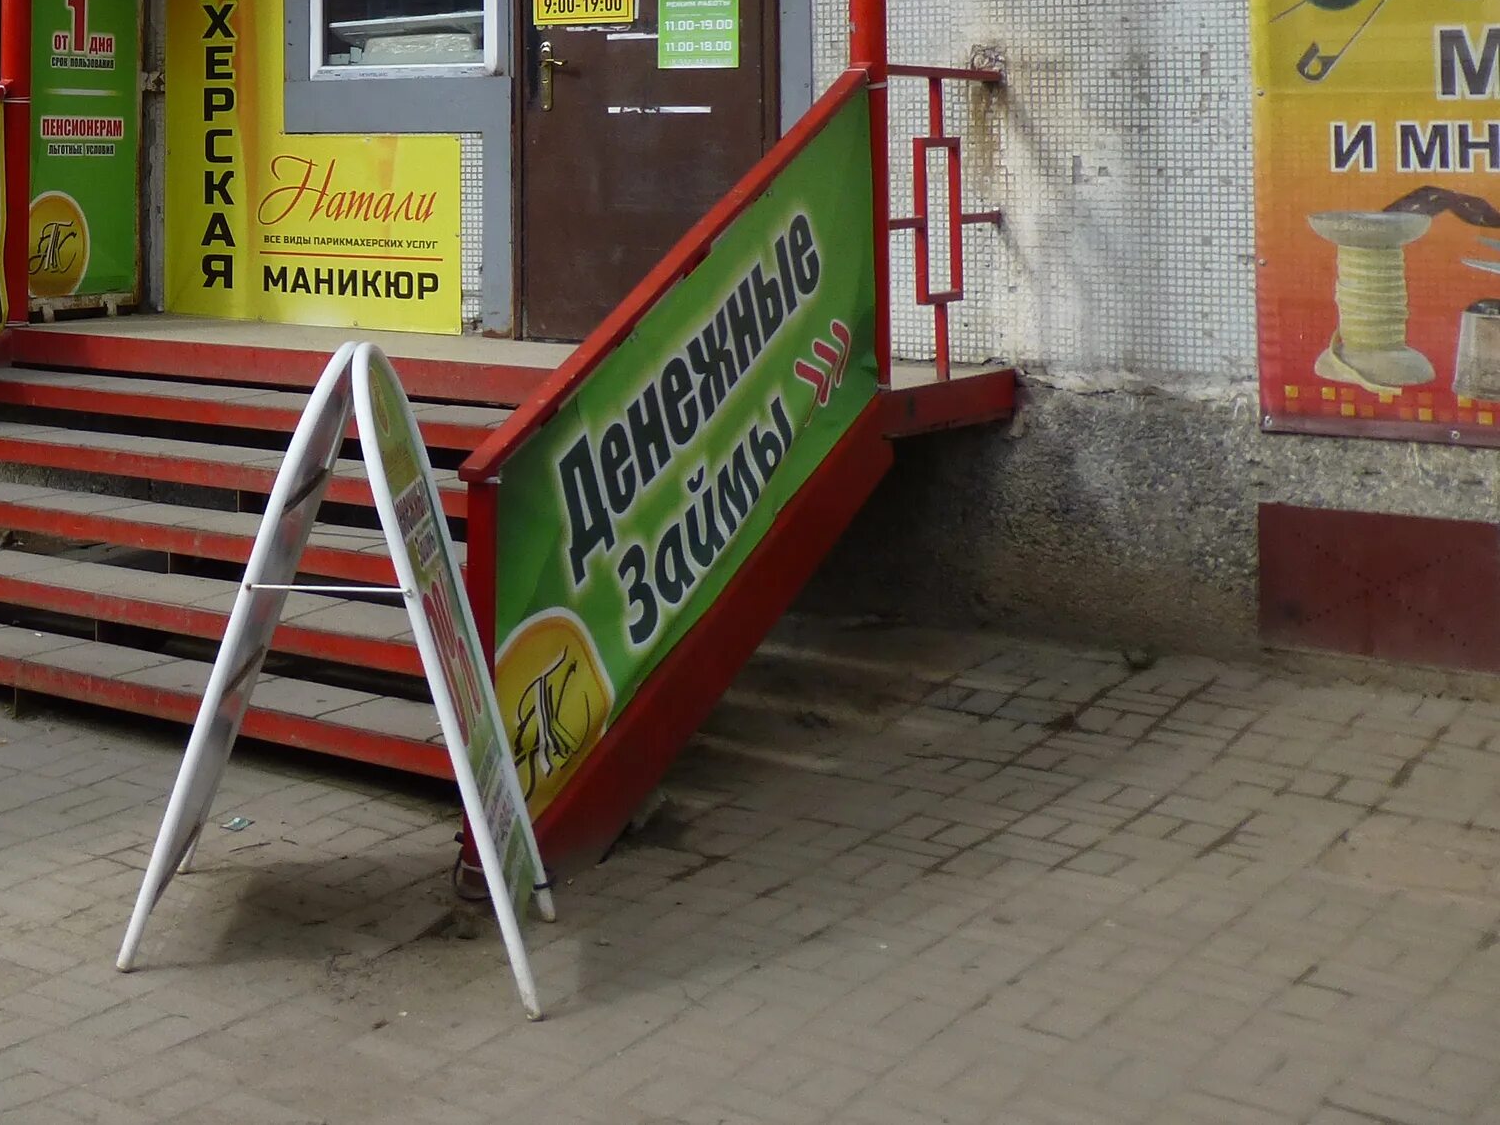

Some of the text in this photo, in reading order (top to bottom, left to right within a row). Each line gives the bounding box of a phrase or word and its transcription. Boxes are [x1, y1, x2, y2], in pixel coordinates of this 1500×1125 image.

[88, 36, 113, 54] ДНЯ
[51, 56, 115, 69] СРОК ПОЛЬЗОВАНИЯ
[41, 118, 123, 137] ПЕНСИОНЕРАМ
[48, 143, 115, 155] ЛЬГОТНЫЕ УСЛОВИЯ
[1334, 124, 1500, 169] И МН
[258, 155, 437, 225] Натали
[263, 234, 438, 250] ВСЕ ВИДЫ ПАРИКМАХЕРСКИХ УСЛУГ
[263, 265, 439, 300] МАНИКЮР
[556, 212, 821, 583] Денежные
[616, 395, 795, 646] Займы
